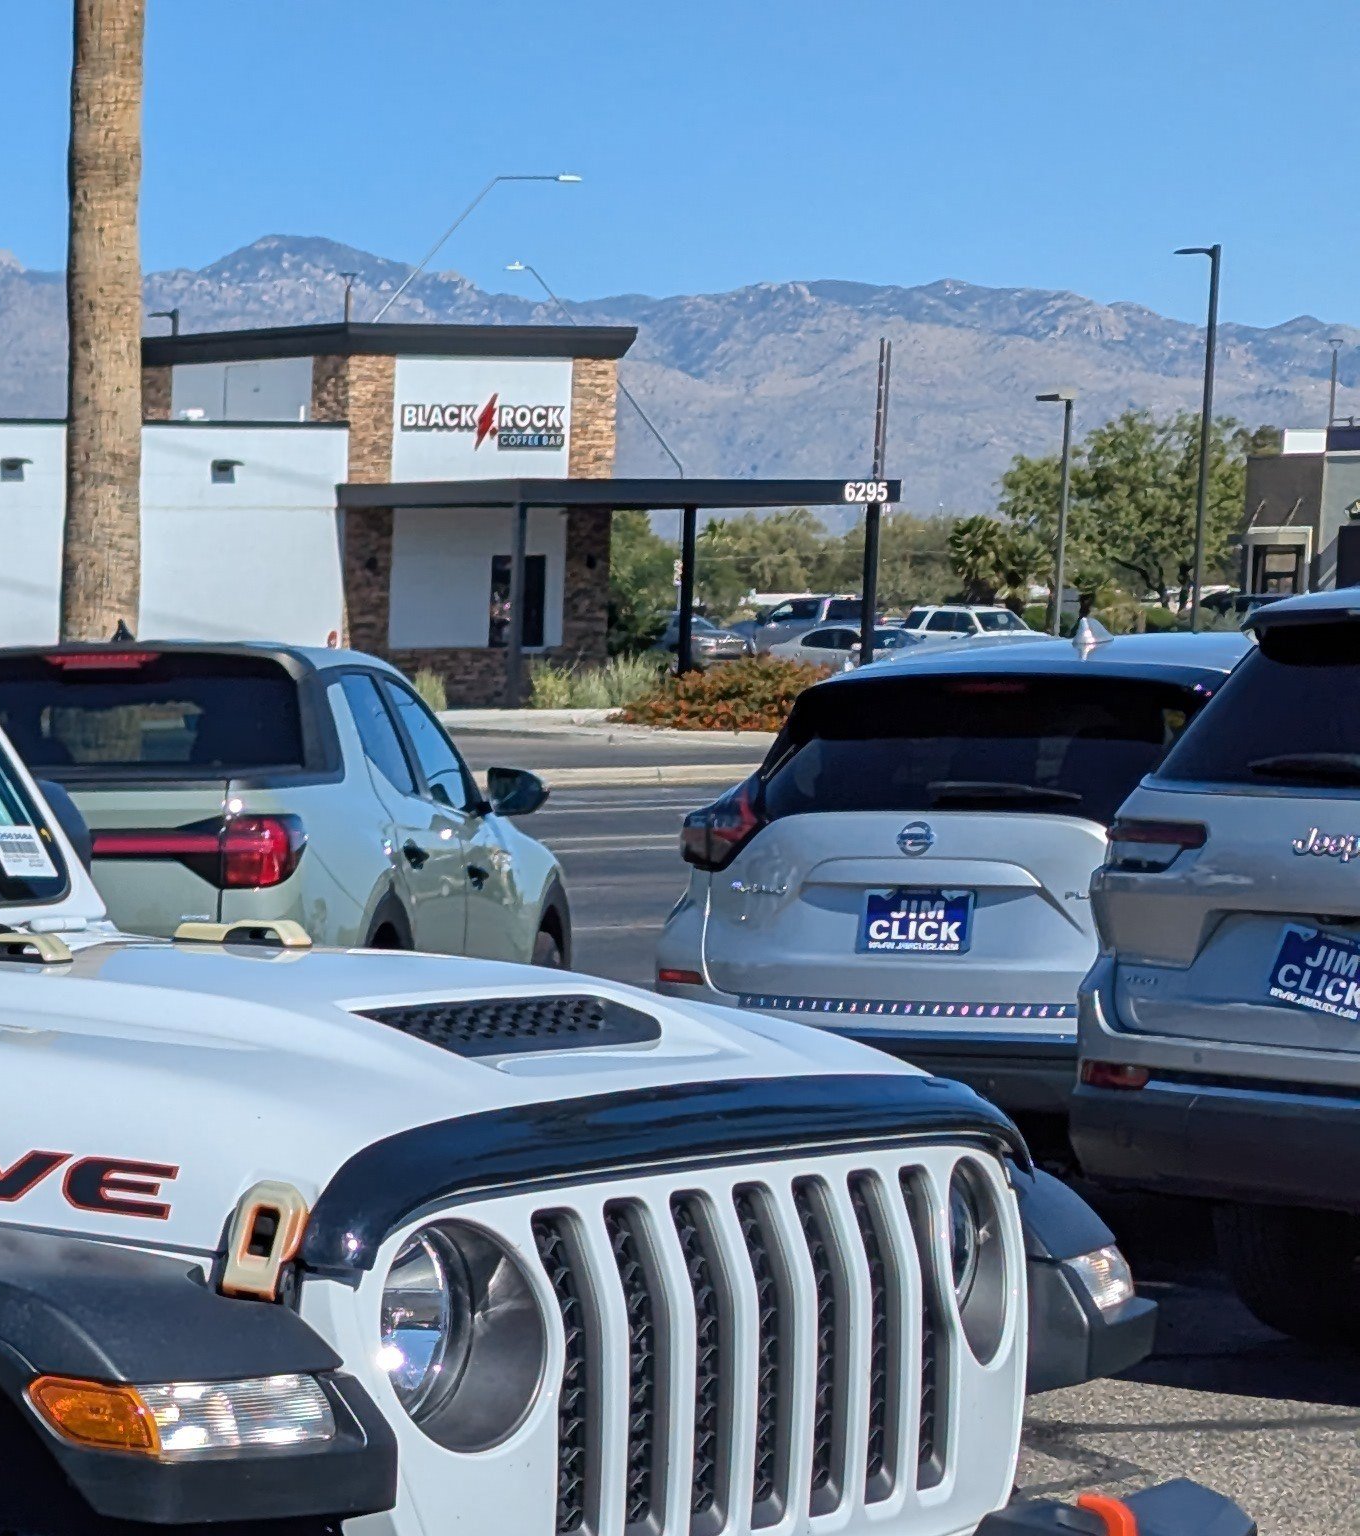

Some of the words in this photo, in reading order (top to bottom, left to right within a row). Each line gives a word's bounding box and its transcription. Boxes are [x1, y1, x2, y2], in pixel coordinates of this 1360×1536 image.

[401, 404, 478, 431] BLACK
[498, 405, 565, 432] ROCK
[500, 435, 539, 446] COFFEE
[844, 482, 889, 502] 6295
[890, 899, 945, 920] JIM
[869, 919, 962, 941] CLICK
[1305, 945, 1360, 978] JIM
[1277, 963, 1360, 1009] CLICK
